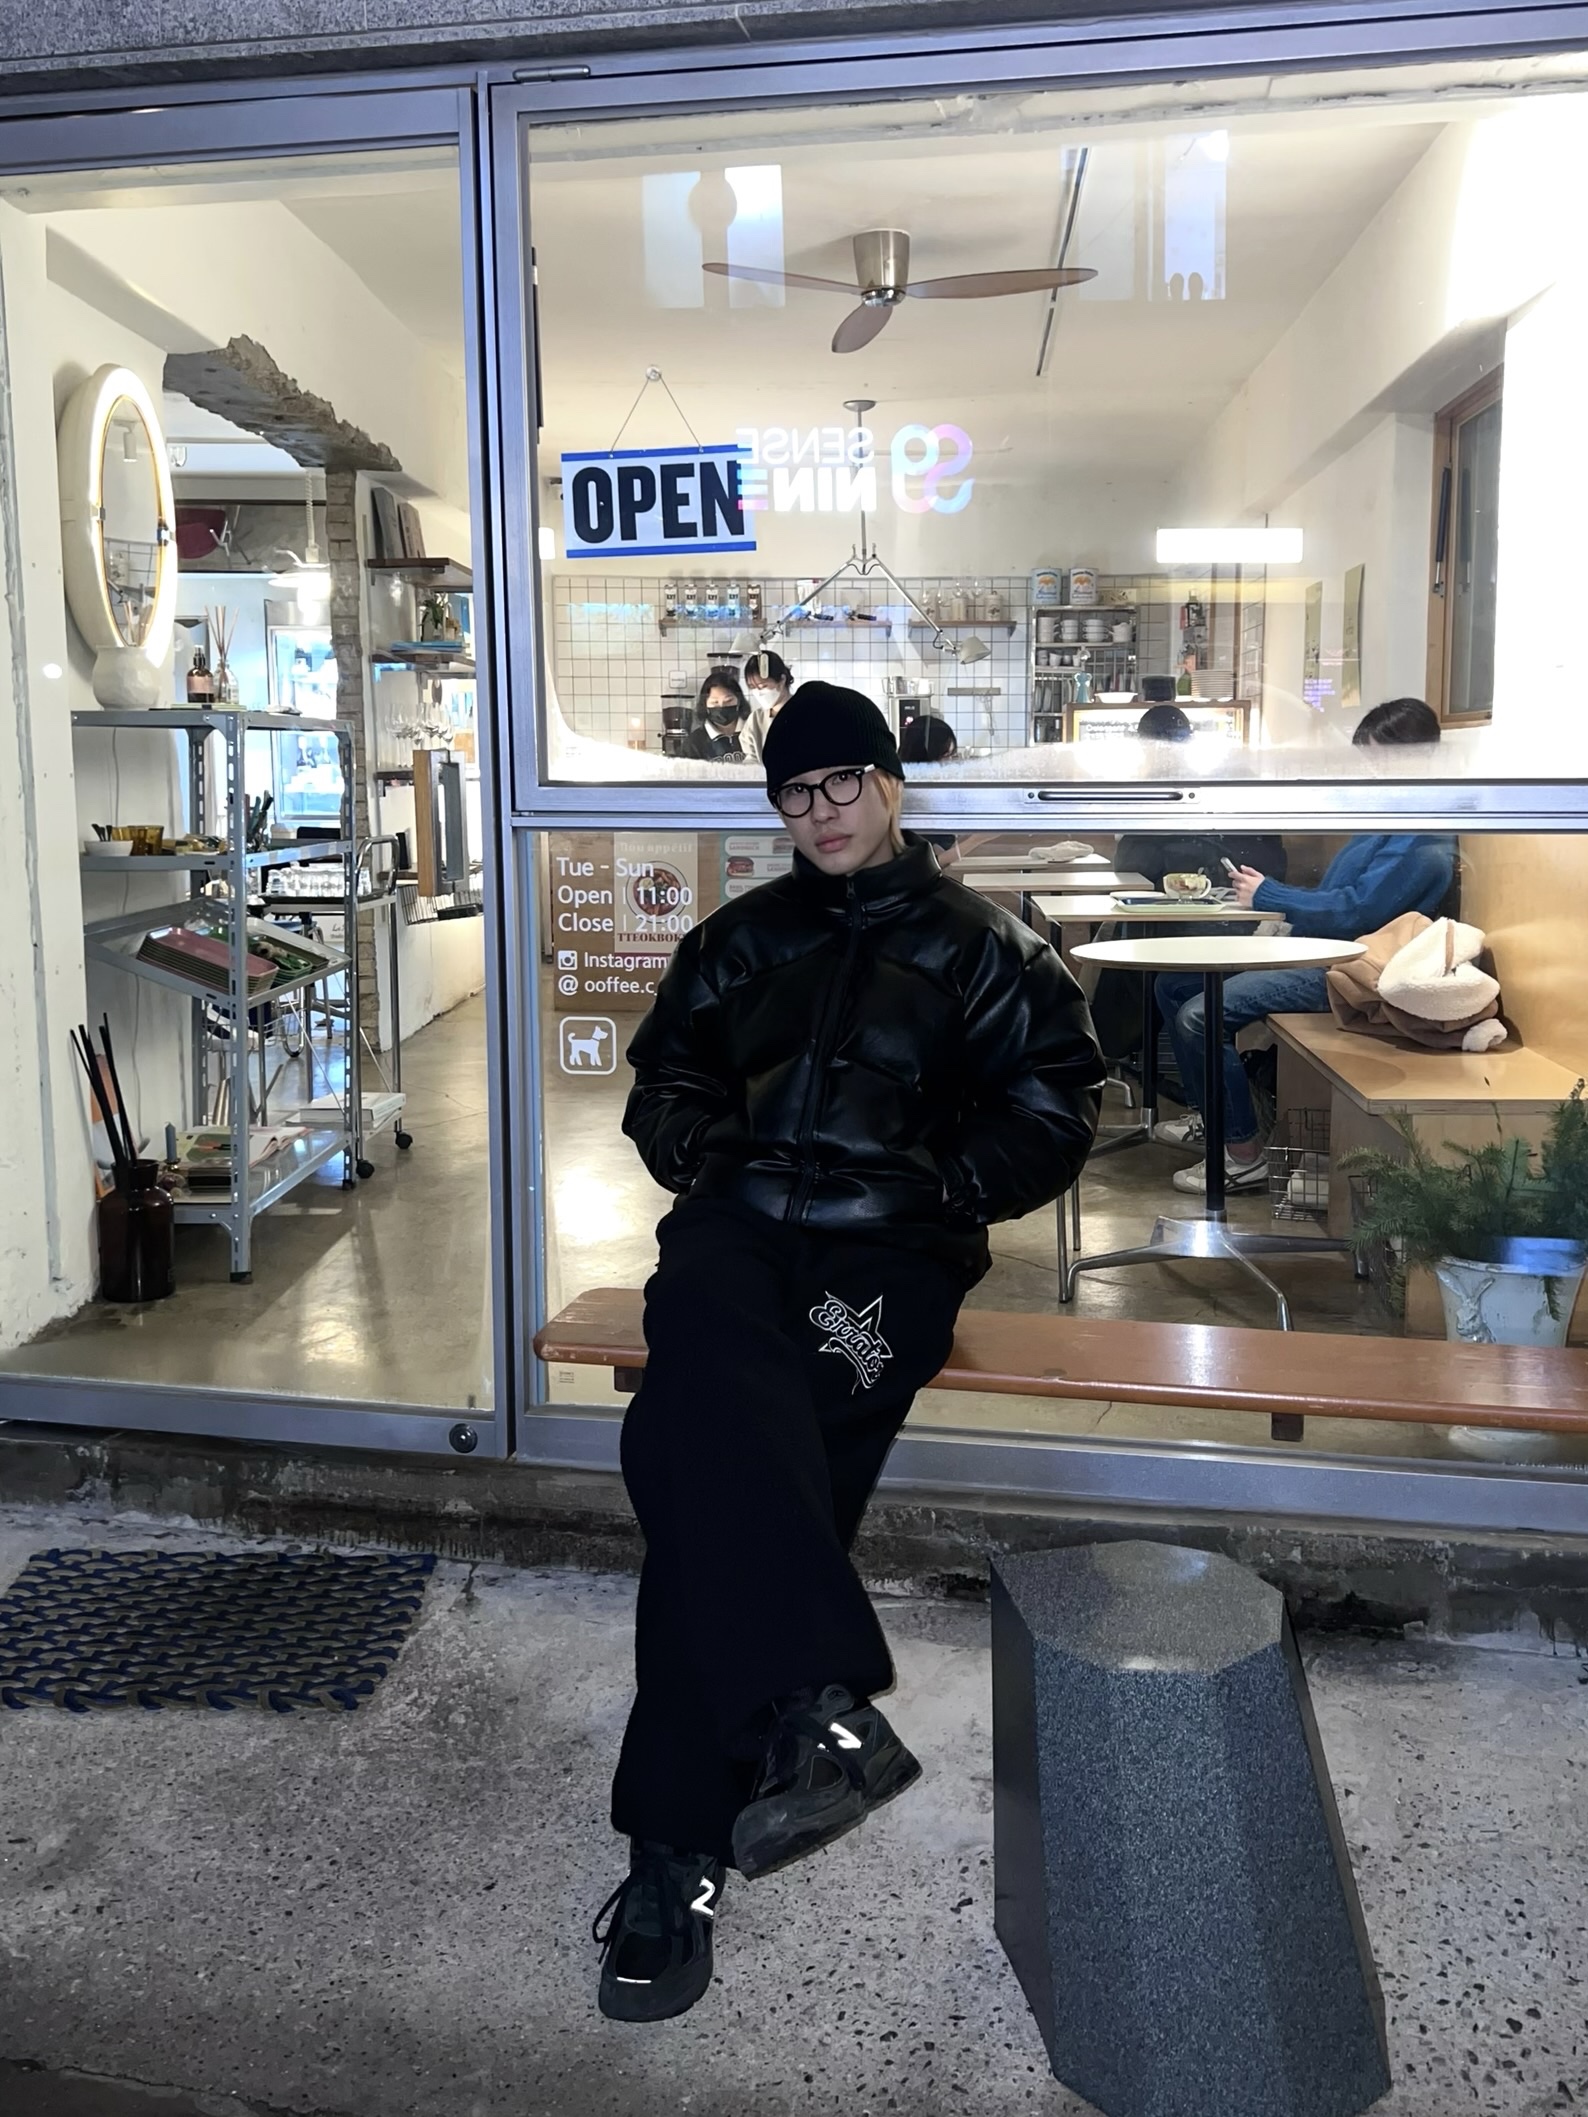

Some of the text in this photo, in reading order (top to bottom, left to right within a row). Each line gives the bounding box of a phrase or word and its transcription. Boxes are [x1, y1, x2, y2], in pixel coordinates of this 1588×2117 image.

[571, 461, 745, 544] OPEN
[556, 857, 594, 876] Tue
[616, 858, 654, 877] Sun
[558, 885, 612, 908] Open
[636, 886, 693, 906] 11:00
[558, 912, 614, 932] Close
[635, 914, 694, 933] 21:00
[584, 952, 667, 972] Instagram
